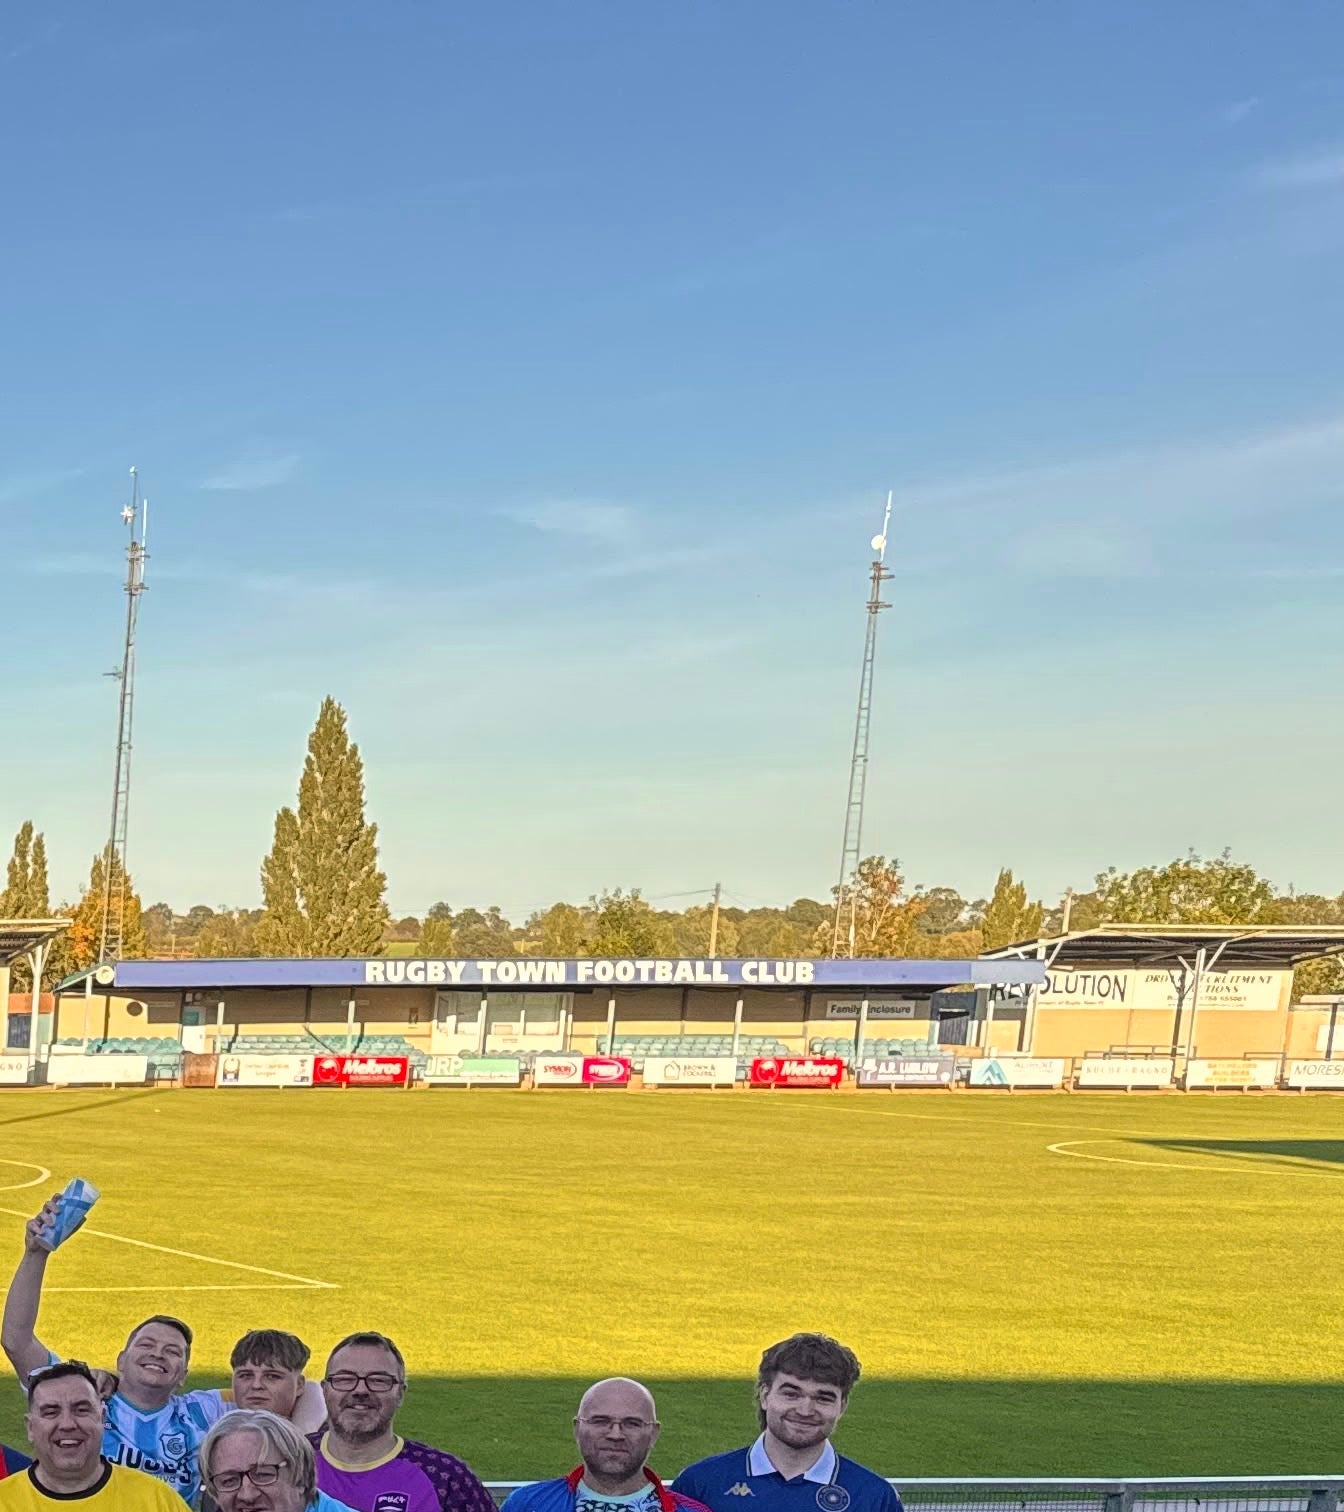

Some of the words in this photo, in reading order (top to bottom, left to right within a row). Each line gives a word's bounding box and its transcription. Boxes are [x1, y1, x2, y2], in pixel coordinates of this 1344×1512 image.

[364, 961, 466, 983] RUGBY
[476, 961, 565, 983] TOWN
[577, 960, 729, 983] FOOTBALL
[741, 961, 815, 983] CLUB
[830, 1004, 862, 1015] Family
[867, 1004, 911, 1014] nclosure
[342, 1058, 402, 1076] Melbros
[781, 1060, 838, 1077] Melbros
